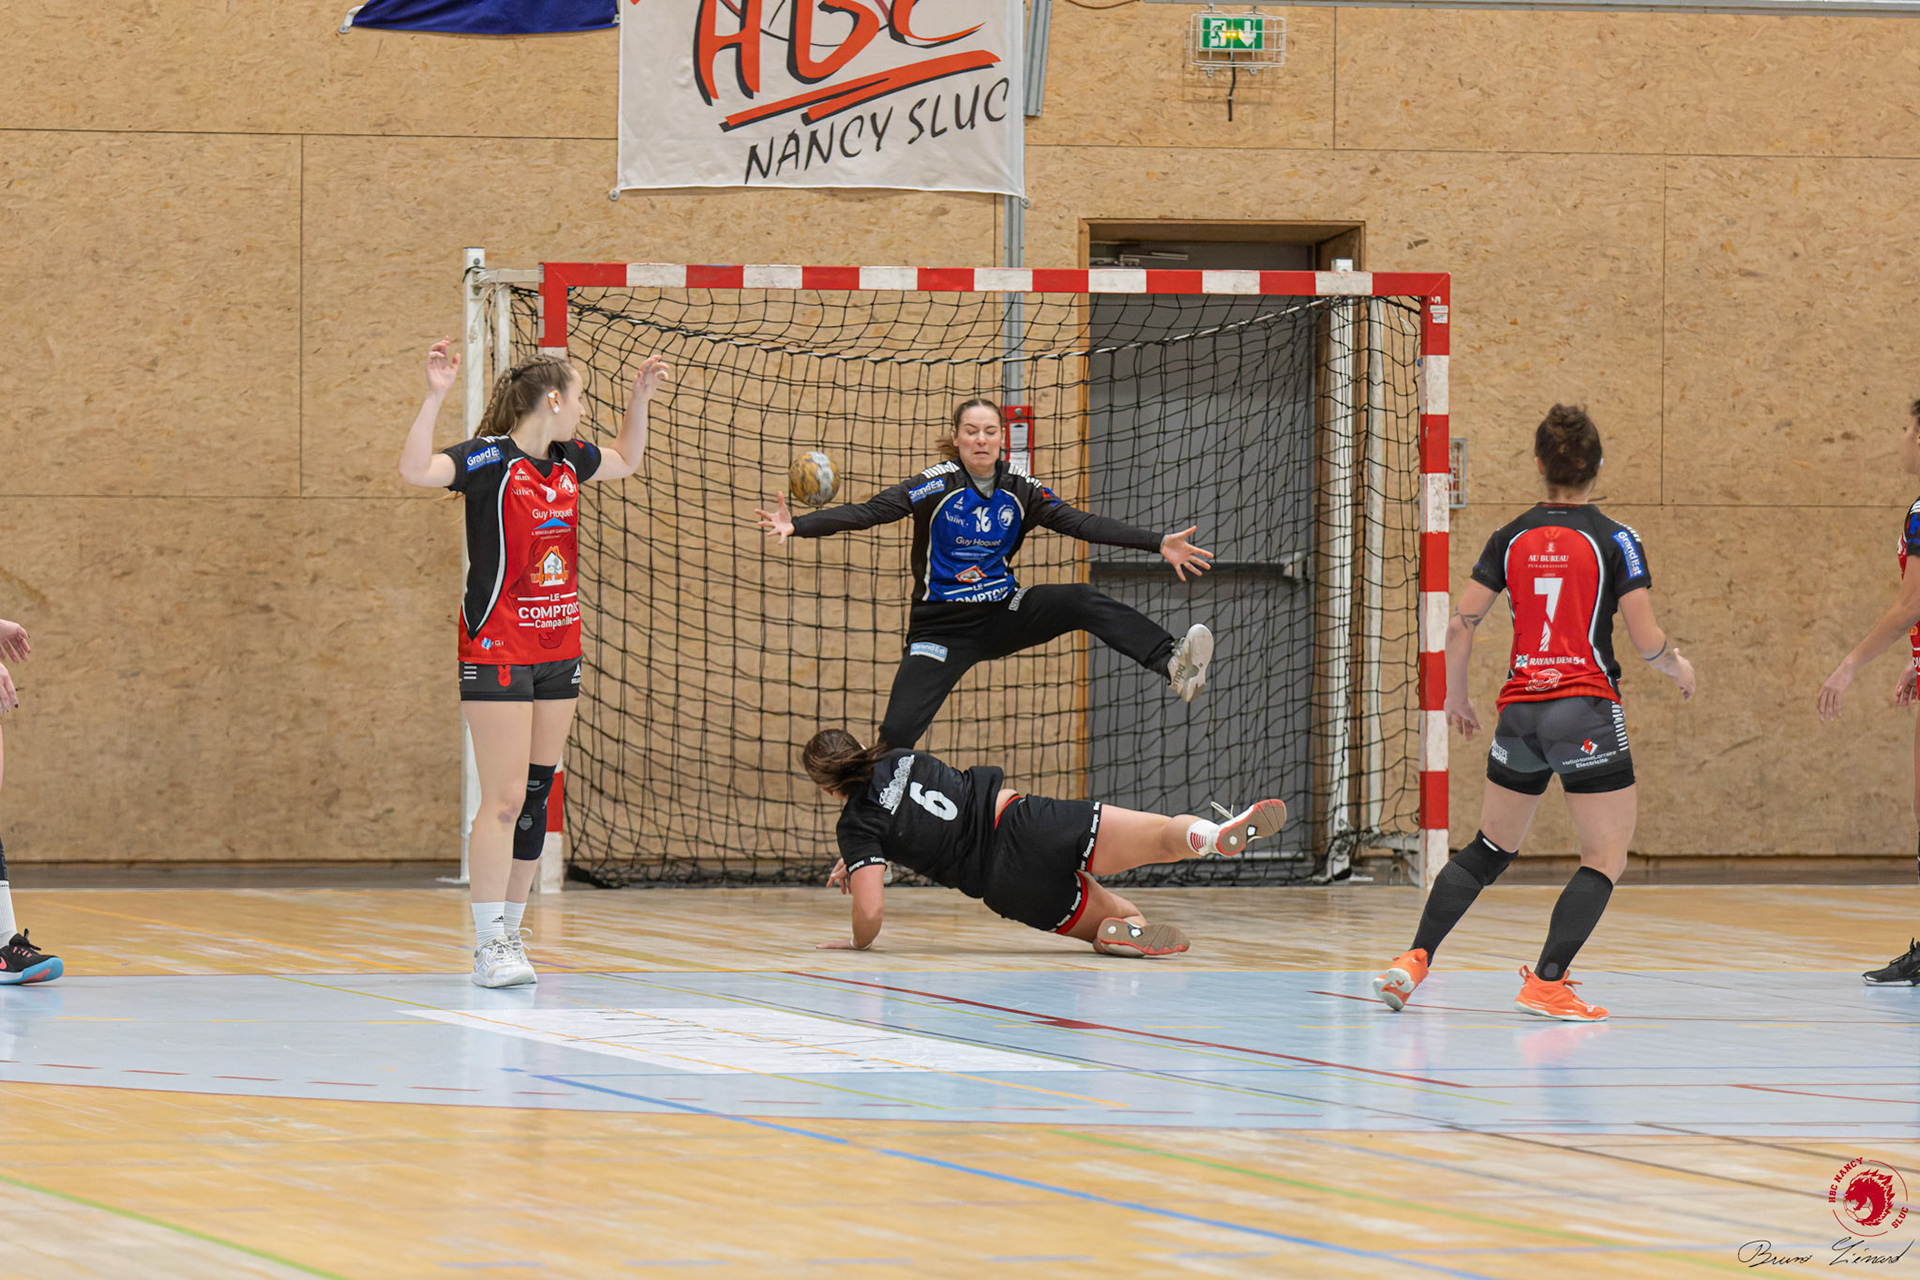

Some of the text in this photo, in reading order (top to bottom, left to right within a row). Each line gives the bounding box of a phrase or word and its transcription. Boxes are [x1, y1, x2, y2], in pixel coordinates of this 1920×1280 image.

[745, 77, 1010, 184] NANCY SLUC
[466, 448, 491, 467] Grand
[532, 508, 573, 520] Guy Hoquet
[972, 506, 992, 533] 16
[955, 536, 1002, 548] Guy Hoquet
[1528, 554, 1569, 562] AU BUREAU
[1618, 531, 1643, 576] Grand Est
[973, 583, 983, 591] LE
[550, 593, 560, 602] LE
[1534, 577, 1563, 652] 7
[535, 616, 573, 630] Campanile
[1529, 657, 1555, 666] RAYAN
[1573, 656, 1586, 665] 54
[909, 781, 959, 821] 6
